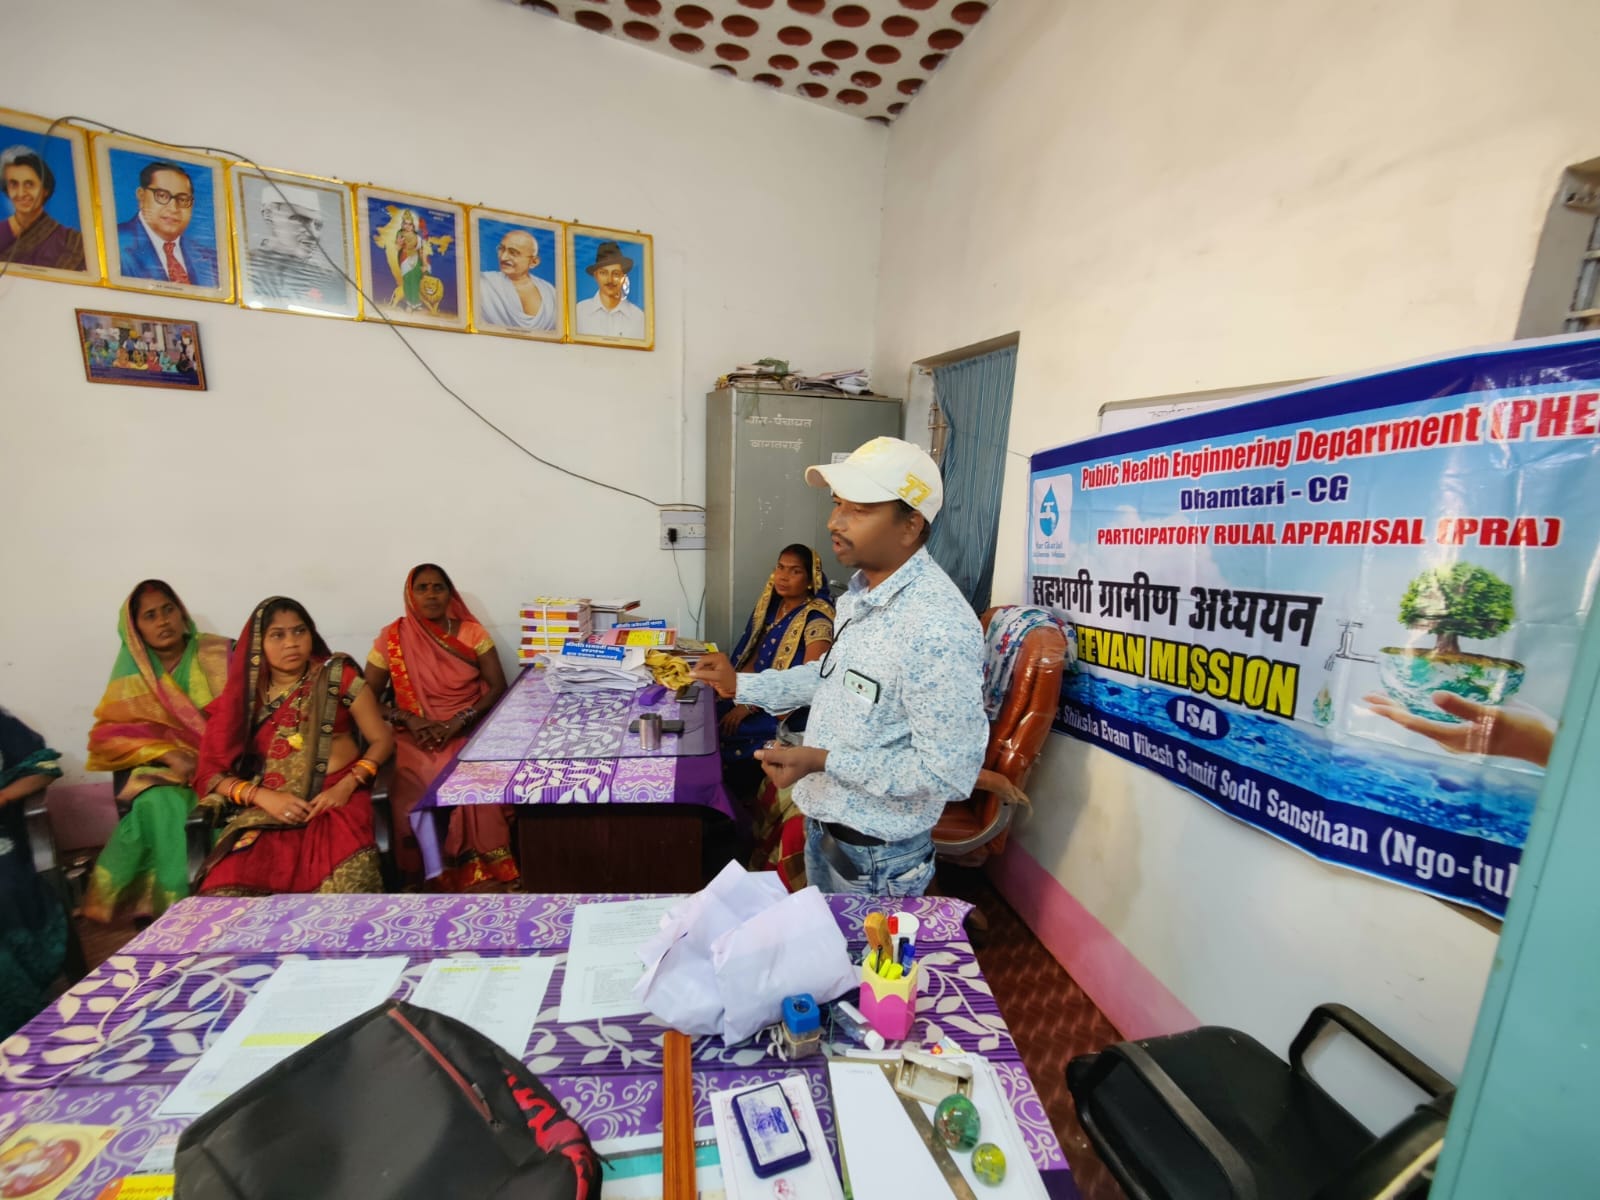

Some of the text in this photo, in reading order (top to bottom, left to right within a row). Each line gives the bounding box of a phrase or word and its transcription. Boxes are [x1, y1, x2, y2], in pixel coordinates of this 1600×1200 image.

[1082, 465, 1119, 489] Public
[1122, 456, 1169, 482] Health
[1173, 438, 1291, 478] Enginnering
[1491, 393, 1600, 439] (PHE
[1181, 481, 1284, 510] Dhamtari
[1308, 474, 1348, 503] CG
[1098, 525, 1210, 545] PARTICIPATORY
[1214, 524, 1276, 545] RULAL
[1282, 518, 1426, 545] APPARISAL
[1033, 569, 1324, 647] सहभागी ग्रामीण अध्ययन
[1074, 624, 1300, 719] EEVAN MISSION
[1176, 700, 1217, 735] ISA
[1101, 719, 1130, 750] Evam
[1133, 731, 1174, 769] Vikash
[1177, 750, 1217, 790] Samiti
[1220, 770, 1261, 810] Sodh
[1266, 788, 1369, 854] Sansthan
[1380, 827, 1518, 899] (Ngo-tul
